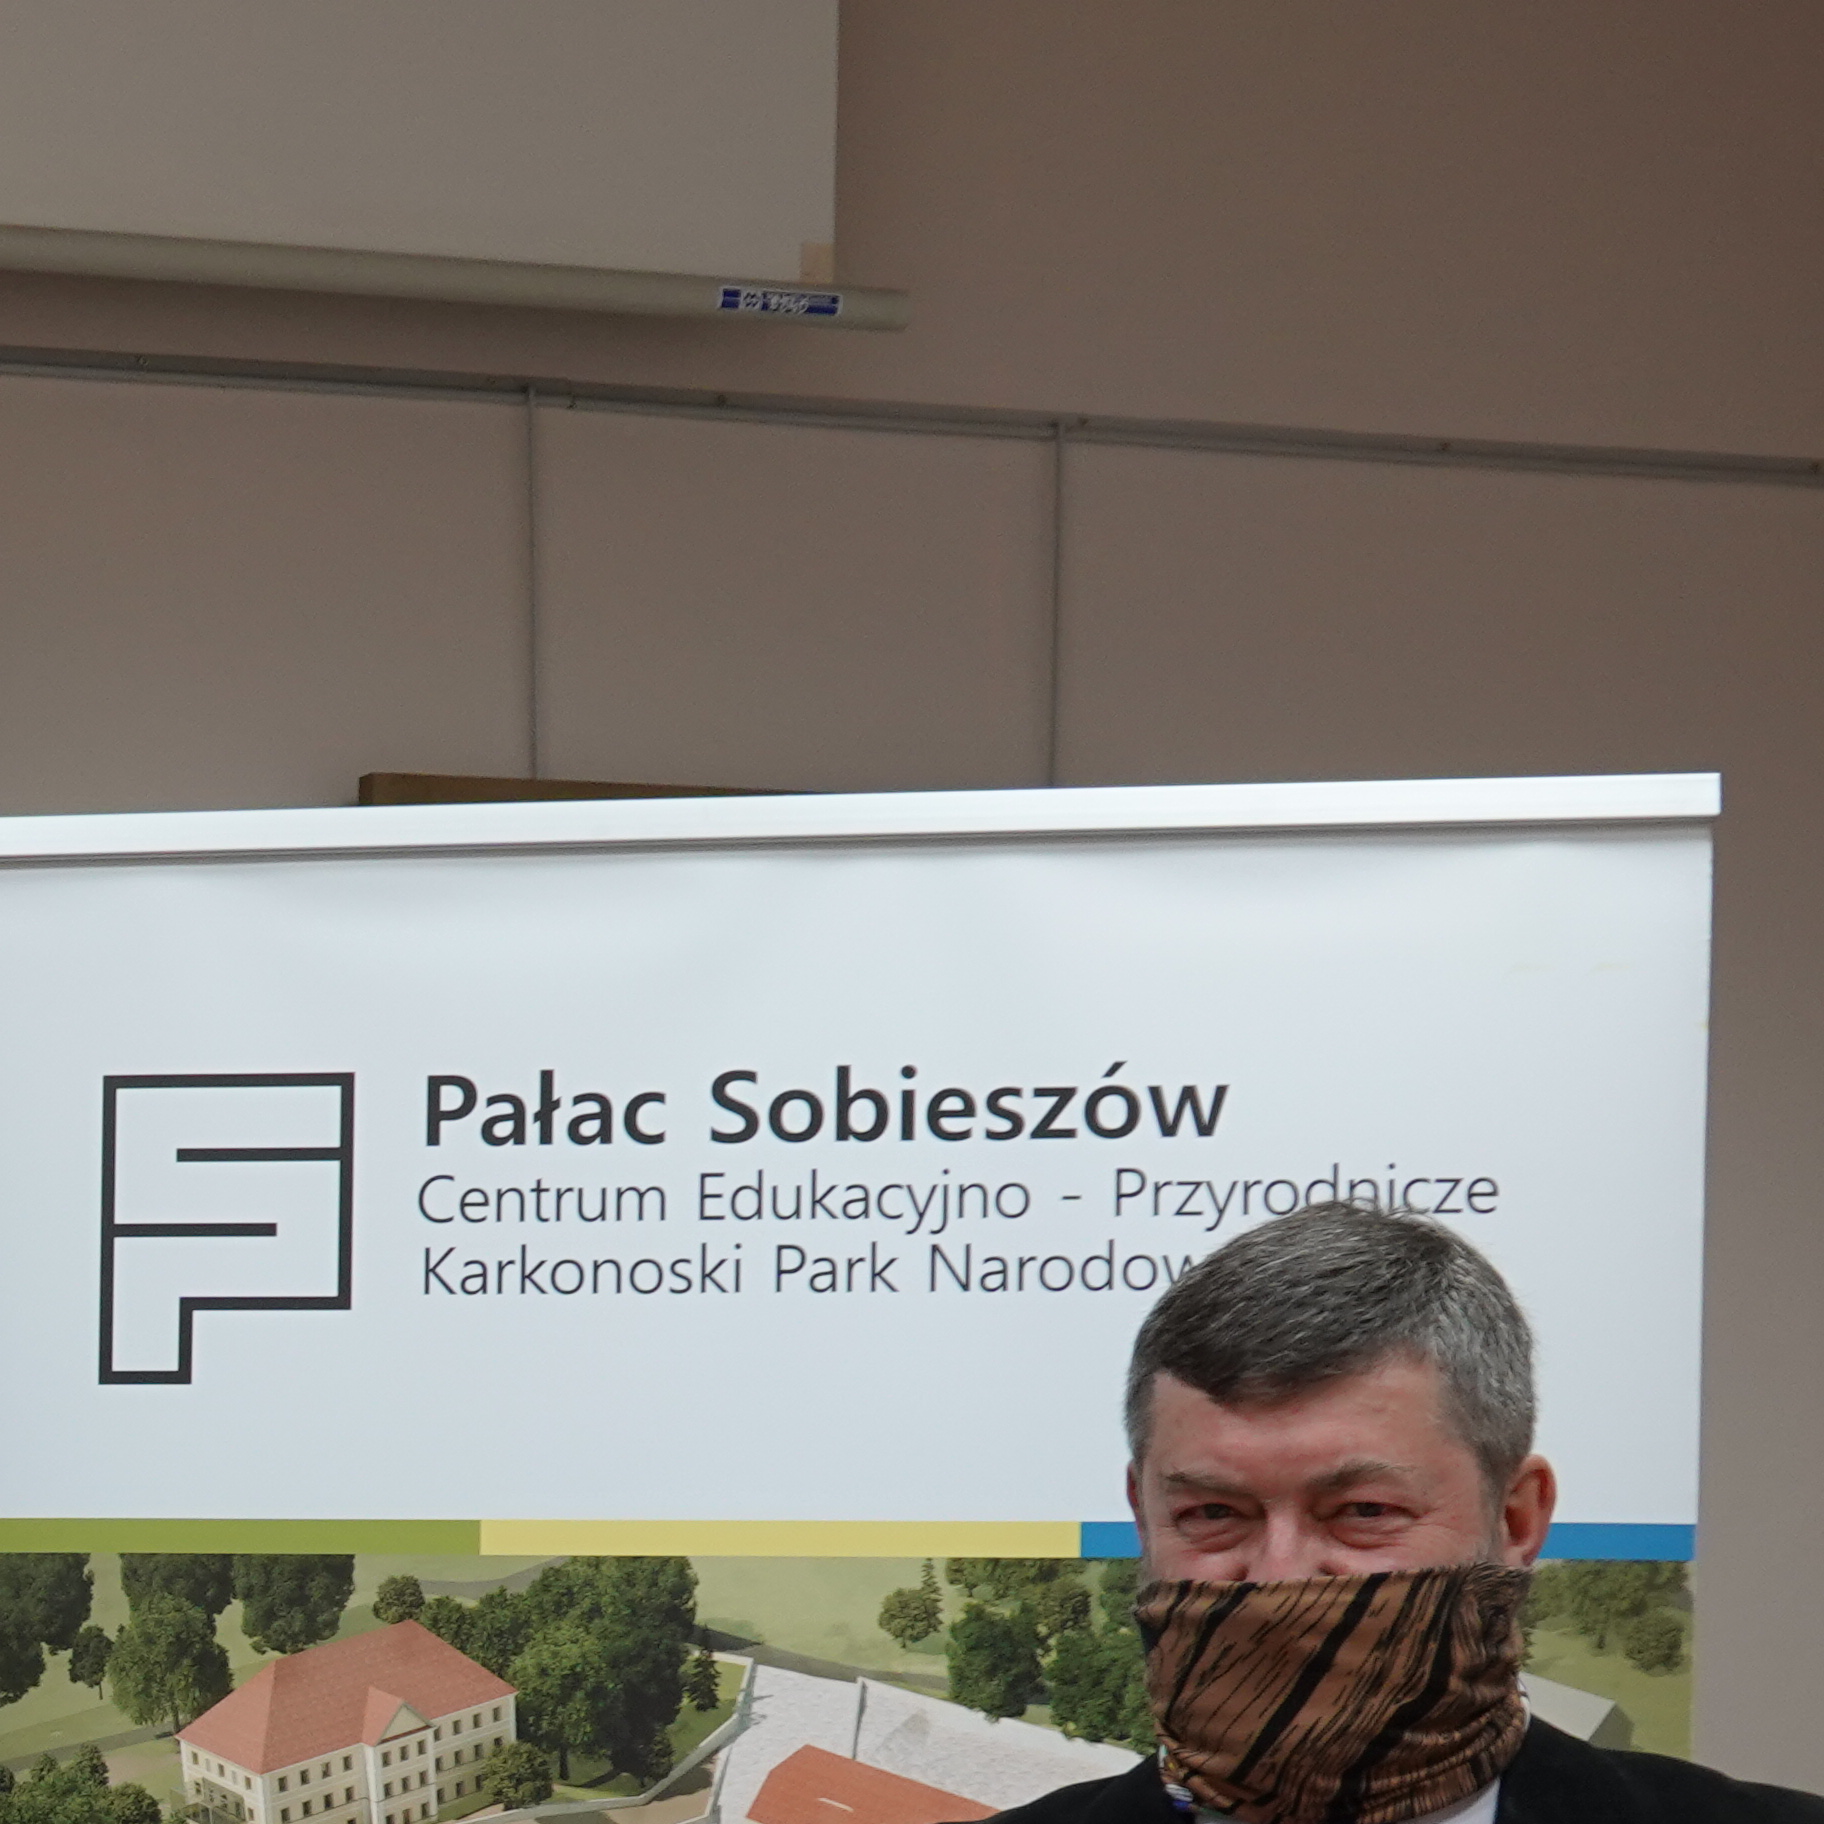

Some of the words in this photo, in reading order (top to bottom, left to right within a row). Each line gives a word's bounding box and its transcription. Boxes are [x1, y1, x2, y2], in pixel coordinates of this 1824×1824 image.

[426, 1069, 666, 1147] Pałac
[710, 1061, 1230, 1144] Sobieszów
[418, 1175, 666, 1224] Centrum
[699, 1168, 1031, 1235] Edukacyjno
[1114, 1163, 1499, 1231] Przyrodnicze
[424, 1242, 742, 1295] Karkonoski
[775, 1241, 899, 1293] Park
